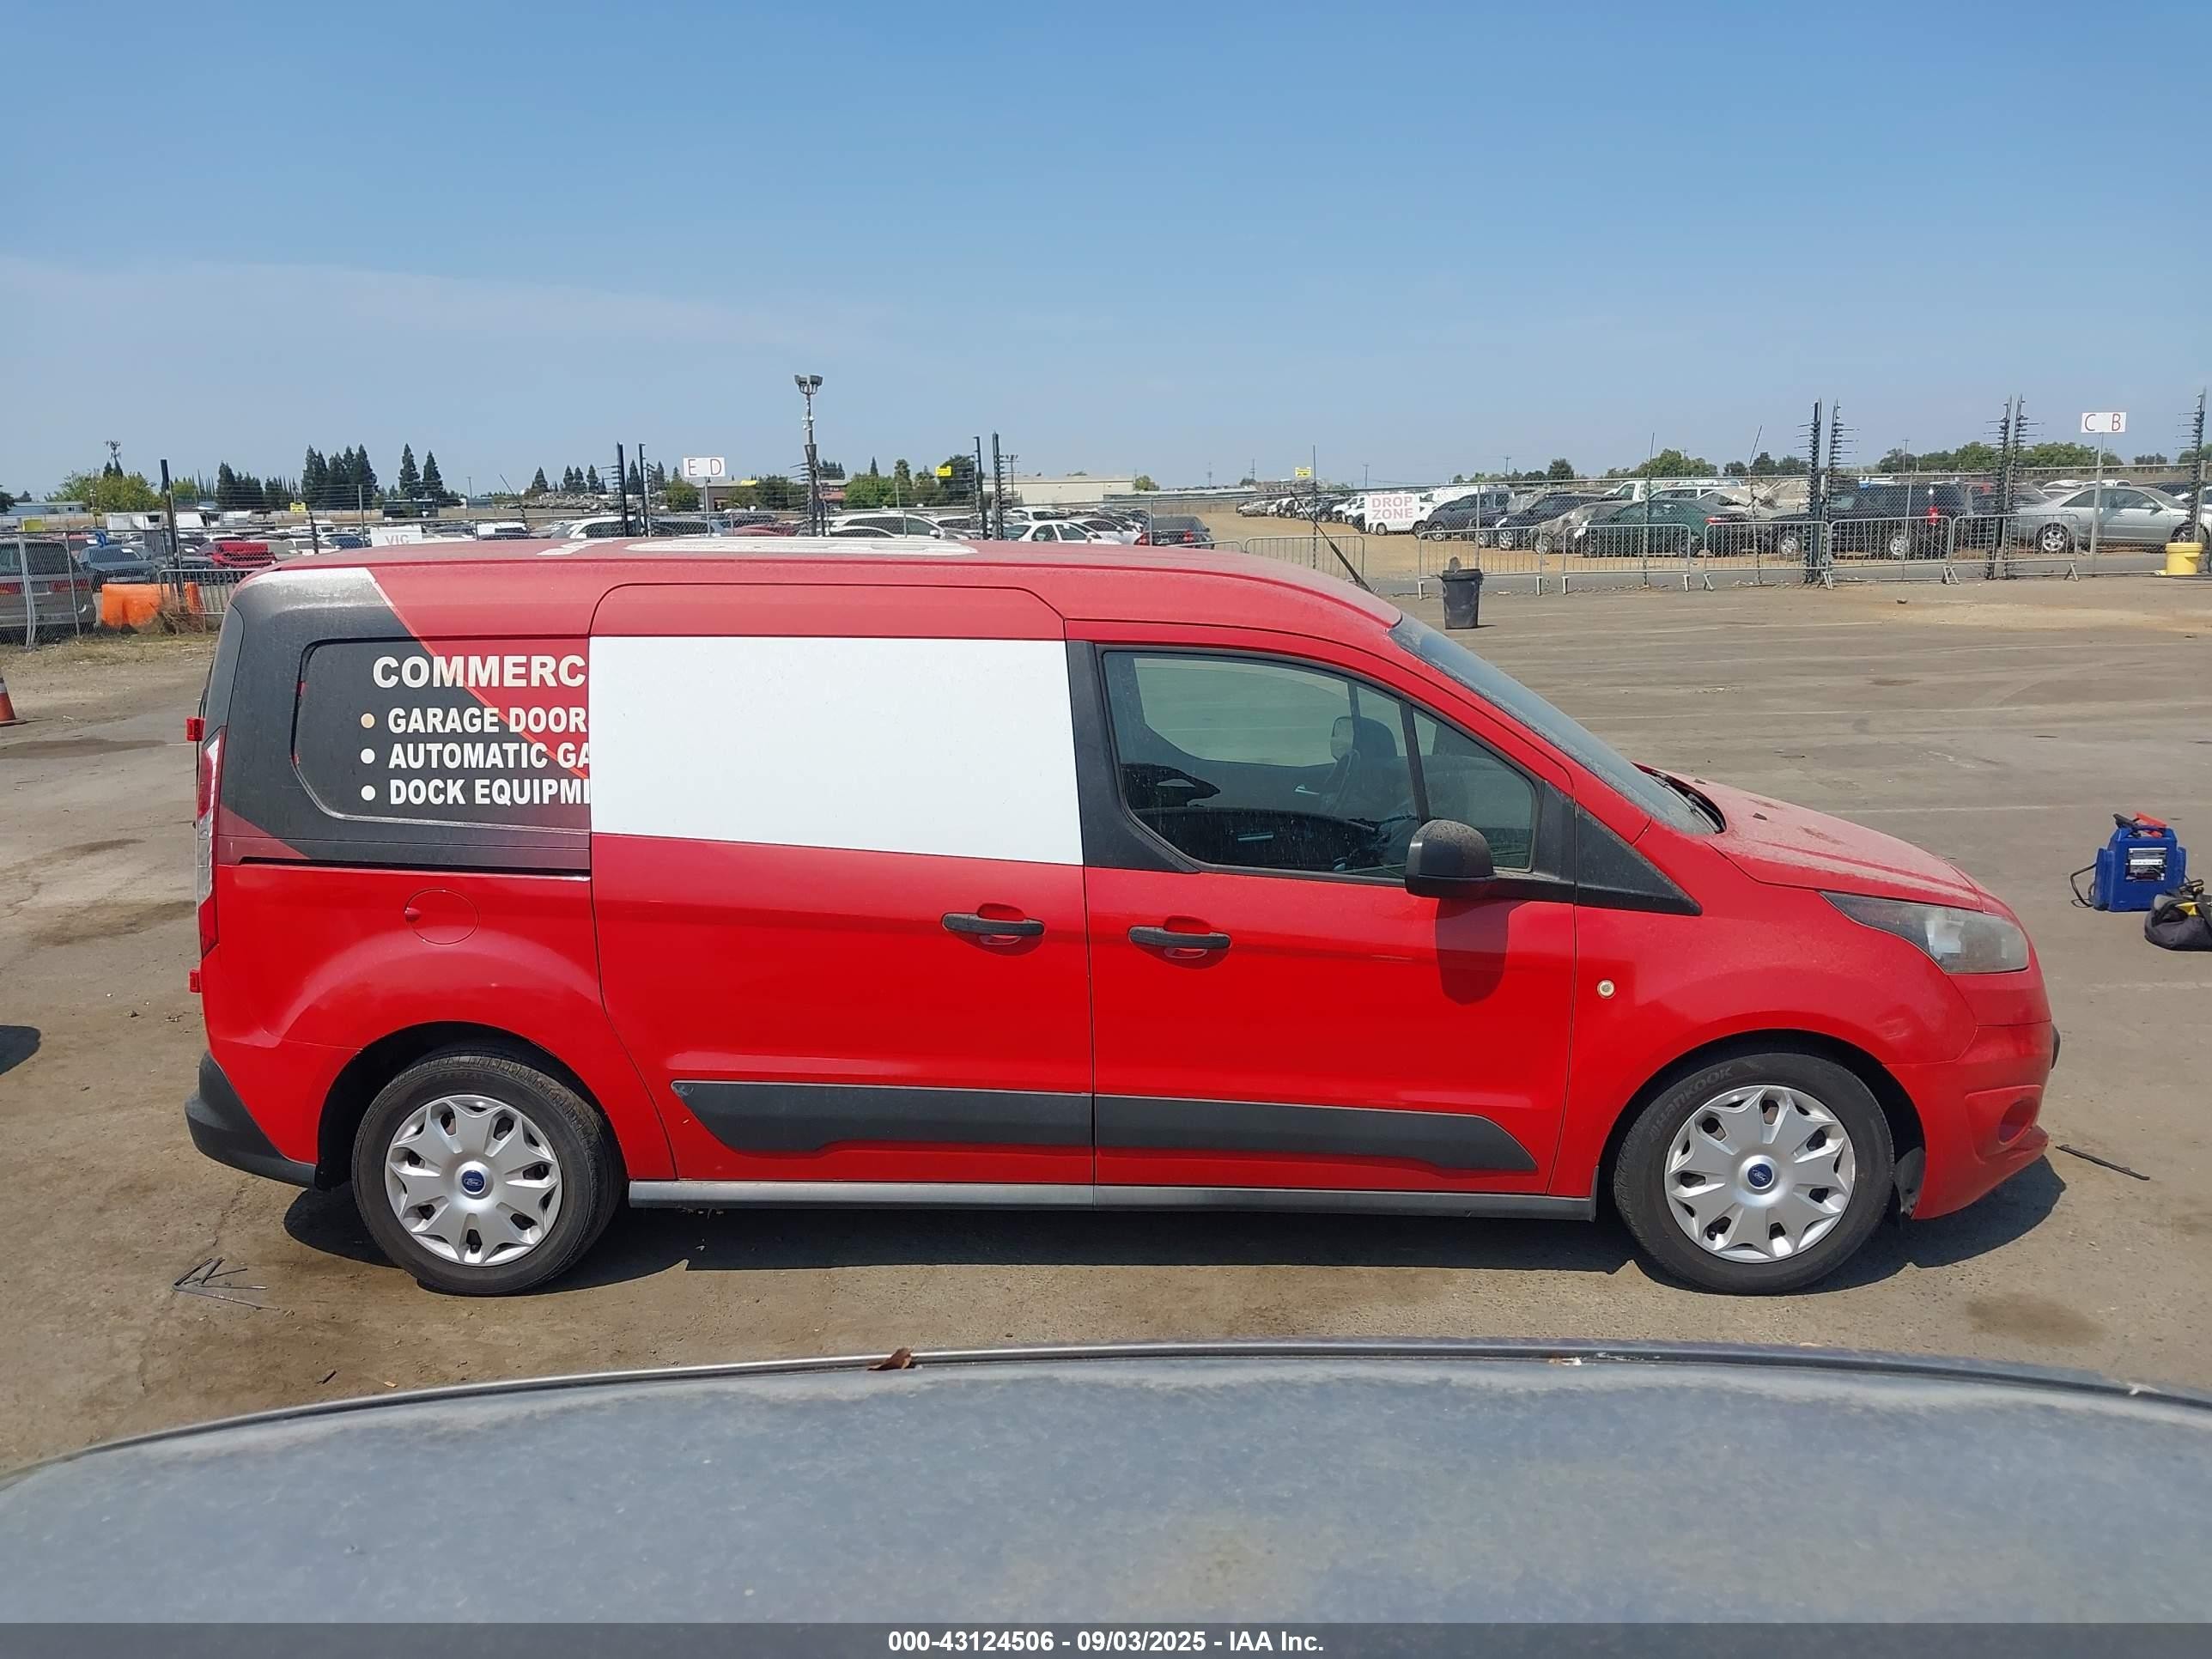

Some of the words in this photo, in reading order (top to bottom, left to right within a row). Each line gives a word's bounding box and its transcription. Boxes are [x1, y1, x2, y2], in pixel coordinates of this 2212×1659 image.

[2085, 414, 2096, 431] C
[2112, 413, 2121, 431] B
[688, 459, 697, 476] E
[710, 459, 722, 476] D
[1371, 495, 1413, 508] DROP
[1371, 507, 1414, 520] ZONE
[373, 654, 586, 689] COMMERC
[387, 707, 500, 733] GARAGE
[508, 706, 588, 733] DOOR
[388, 742, 549, 769] AUTOMATIC
[390, 779, 466, 805] DOCK
